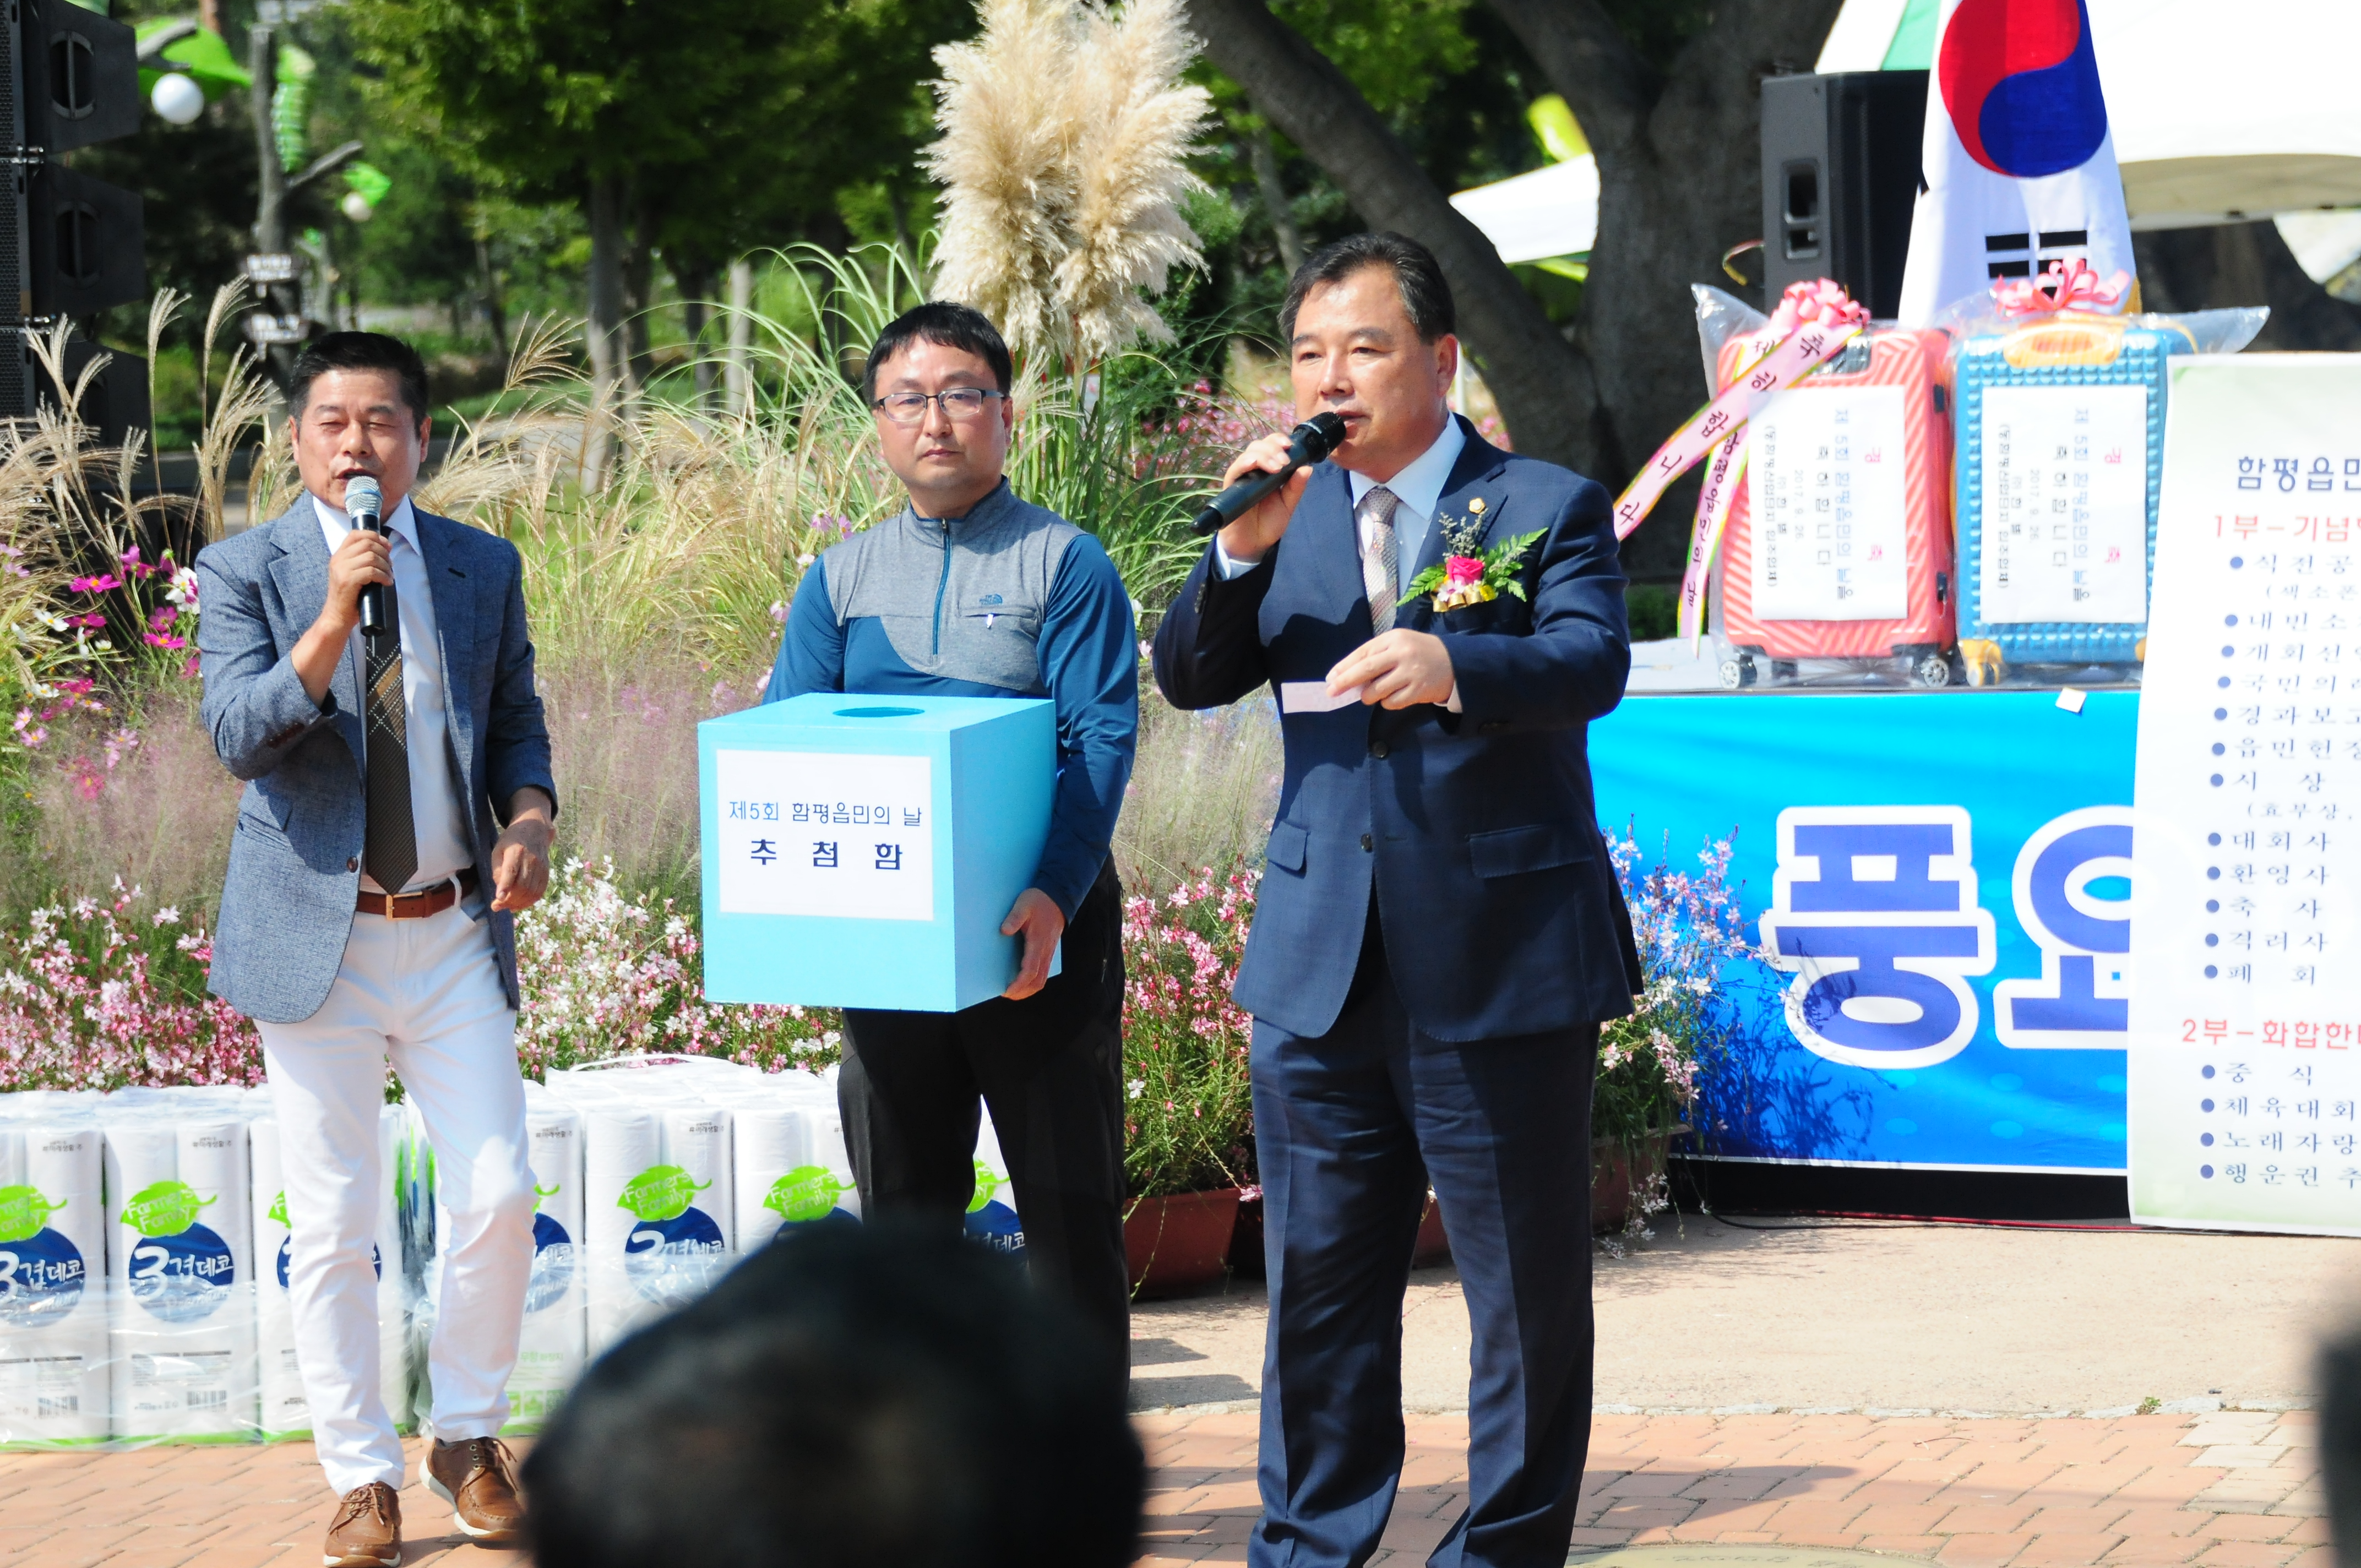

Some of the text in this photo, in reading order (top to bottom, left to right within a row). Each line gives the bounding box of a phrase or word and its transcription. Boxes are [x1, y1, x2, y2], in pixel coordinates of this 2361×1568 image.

[1619, 334, 1824, 525] 축하합니다
[1835, 472, 1853, 557] 함평읍민의
[2072, 472, 2090, 558] 함평읍민의
[2214, 514, 2361, 543] 1부-기념
[2249, 611, 2361, 631] 내빈소
[729, 800, 922, 827] 제5회 함평읍민의 날
[2232, 830, 2331, 853] 대회사
[2229, 863, 2330, 886] 환영사
[2182, 1018, 2361, 1050] 2부-화합한
